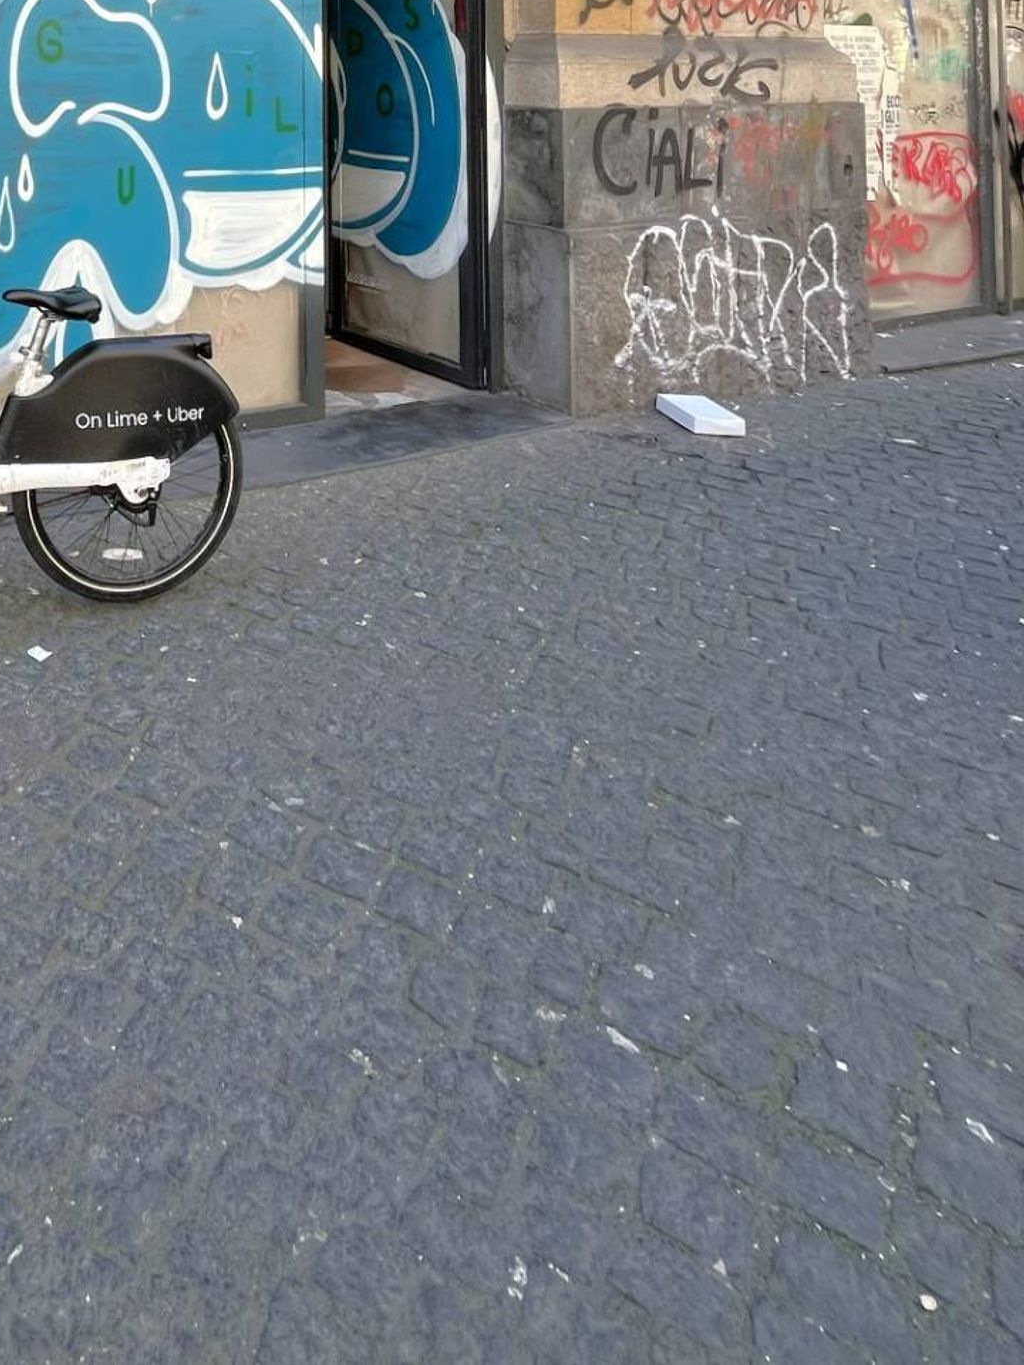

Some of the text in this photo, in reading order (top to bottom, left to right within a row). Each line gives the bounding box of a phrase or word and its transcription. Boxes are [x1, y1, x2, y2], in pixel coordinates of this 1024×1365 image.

[36, 19, 65, 64] G
[116, 165, 136, 206] U
[75, 412, 103, 429] On
[106, 410, 149, 428] Lime
[167, 406, 205, 423] Uber
